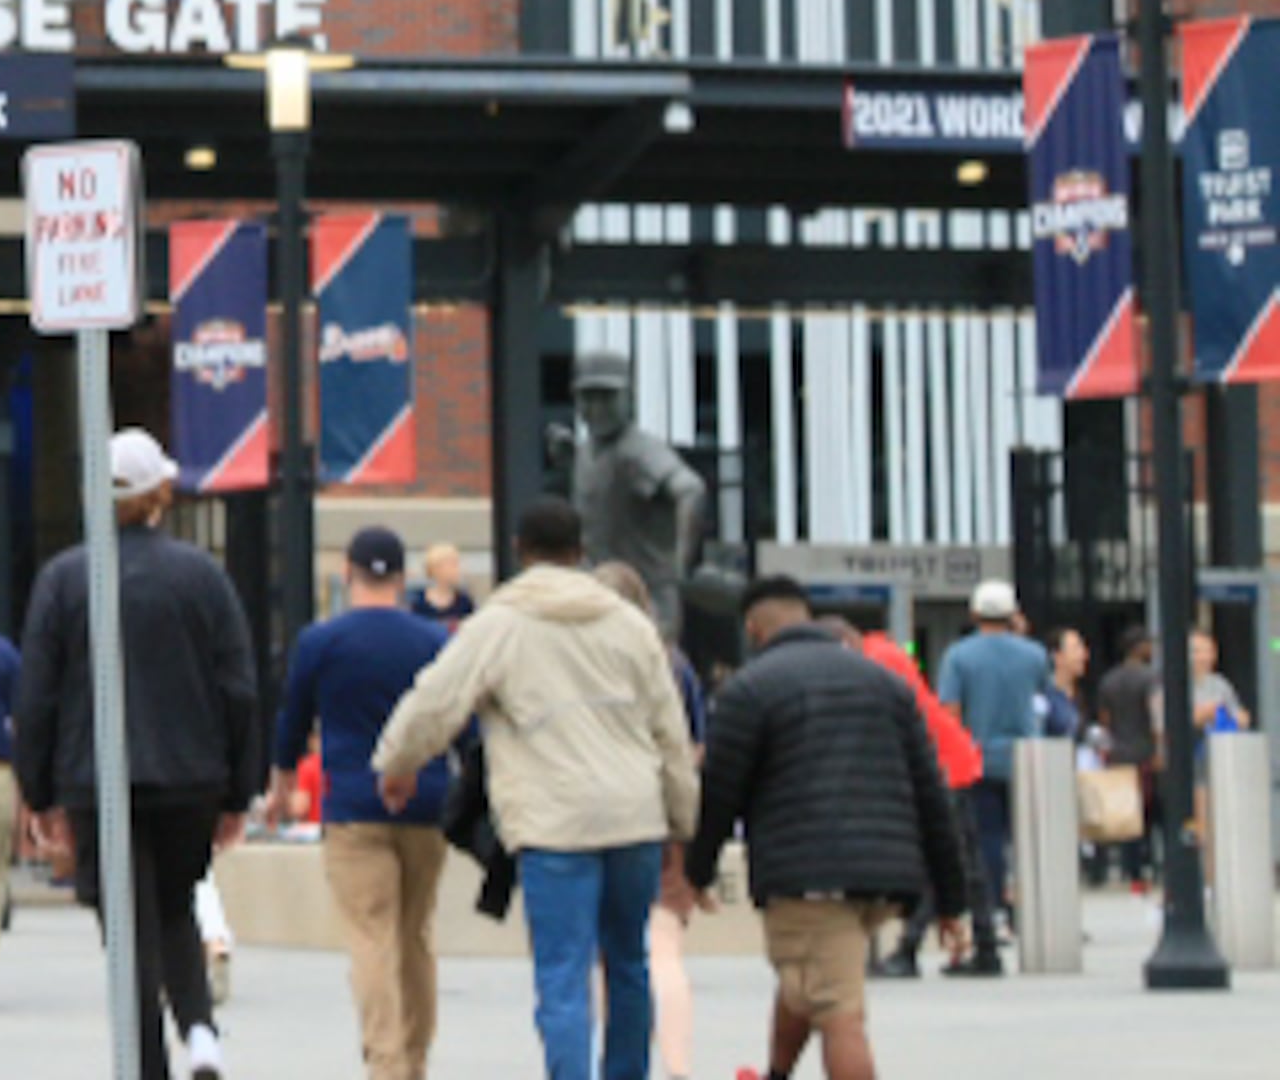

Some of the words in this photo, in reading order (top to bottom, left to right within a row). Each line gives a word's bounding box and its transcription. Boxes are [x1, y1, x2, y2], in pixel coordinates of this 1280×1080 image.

[852, 92, 934, 137] 2021
[57, 169, 98, 201] NO
[58, 282, 108, 306] LANE
